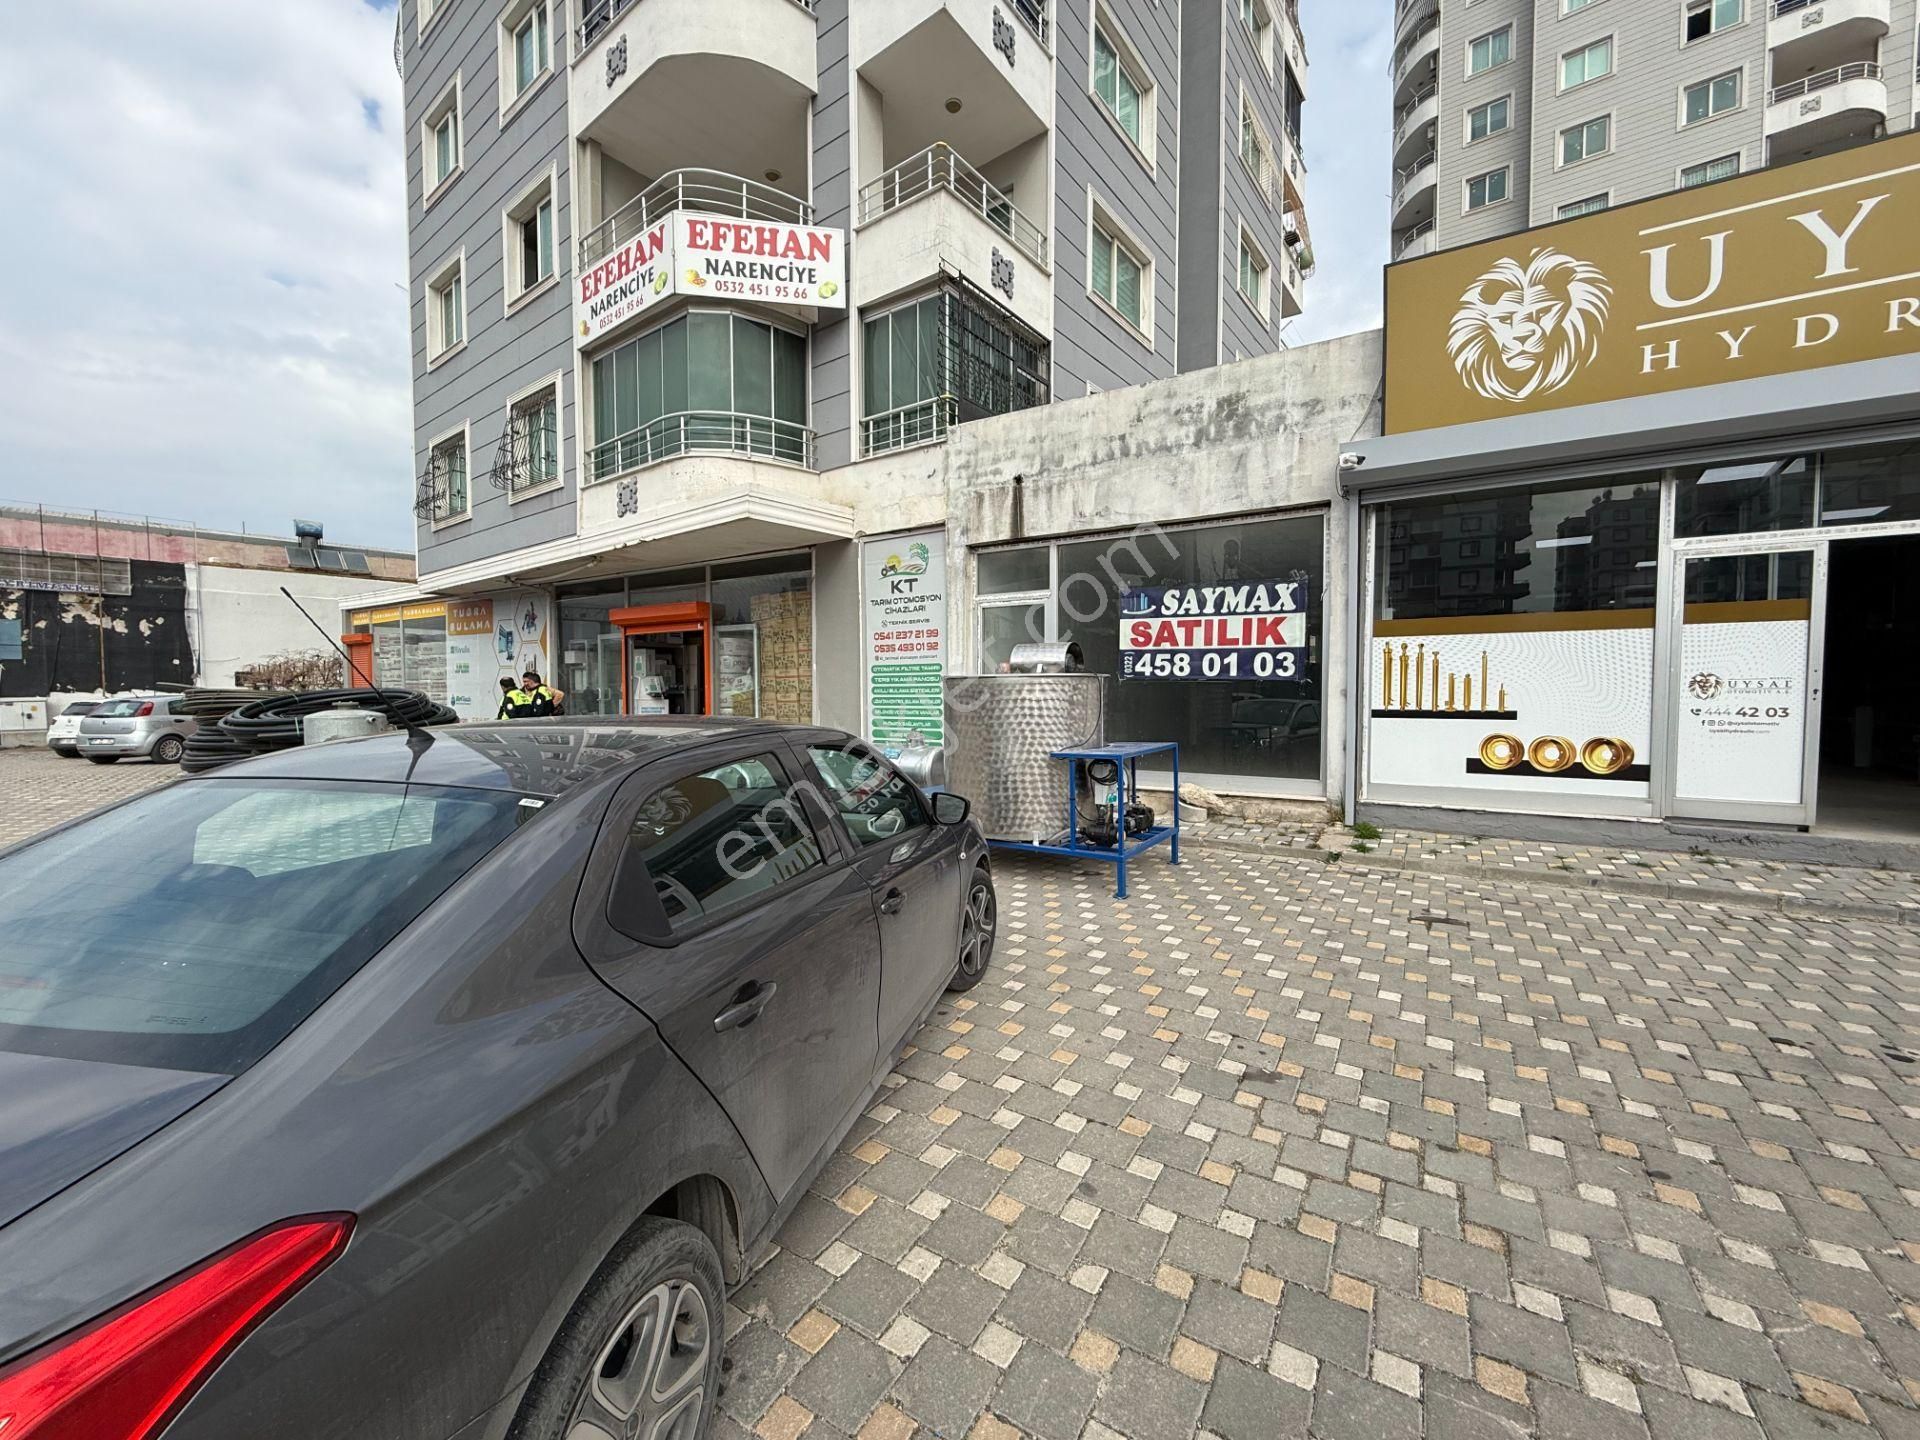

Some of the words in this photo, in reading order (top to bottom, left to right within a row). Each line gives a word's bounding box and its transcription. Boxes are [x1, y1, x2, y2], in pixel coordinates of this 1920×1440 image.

[687, 219, 833, 263] EFEHAN
[581, 224, 665, 304] EFEHAN
[705, 258, 817, 285] NARENCİYE
[590, 266, 655, 320] NARENCİYE
[715, 280, 744, 293] 0532
[749, 282, 769, 296] 451
[775, 284, 789, 298] 95
[794, 287, 808, 299] 66
[599, 313, 613, 329] 0532
[614, 307, 625, 320] 451
[626, 299, 634, 313] 95
[636, 294, 644, 307] 66
[891, 578, 918, 594] KT
[870, 599, 892, 607] TARIM
[893, 594, 941, 605] OTOMOSYON
[885, 605, 926, 614] CİHAZLARI
[1161, 582, 1299, 616] SAYMAX
[874, 632, 894, 641] 0541
[896, 630, 913, 640] 237
[915, 629, 924, 639] 21
[926, 628, 939, 638] 99
[1130, 616, 1288, 648] SATILIK
[874, 644, 896, 653] 0535
[897, 643, 914, 652] 493
[916, 642, 924, 651] 01
[926, 642, 939, 651] 92
[1134, 652, 1191, 677] 458
[1202, 652, 1238, 677] 01
[1253, 652, 1297, 677] 03
[1728, 680, 1792, 688] UYSAL
[1704, 707, 1732, 716] 444
[1735, 706, 1759, 718] 42
[1765, 706, 1790, 718] 03
